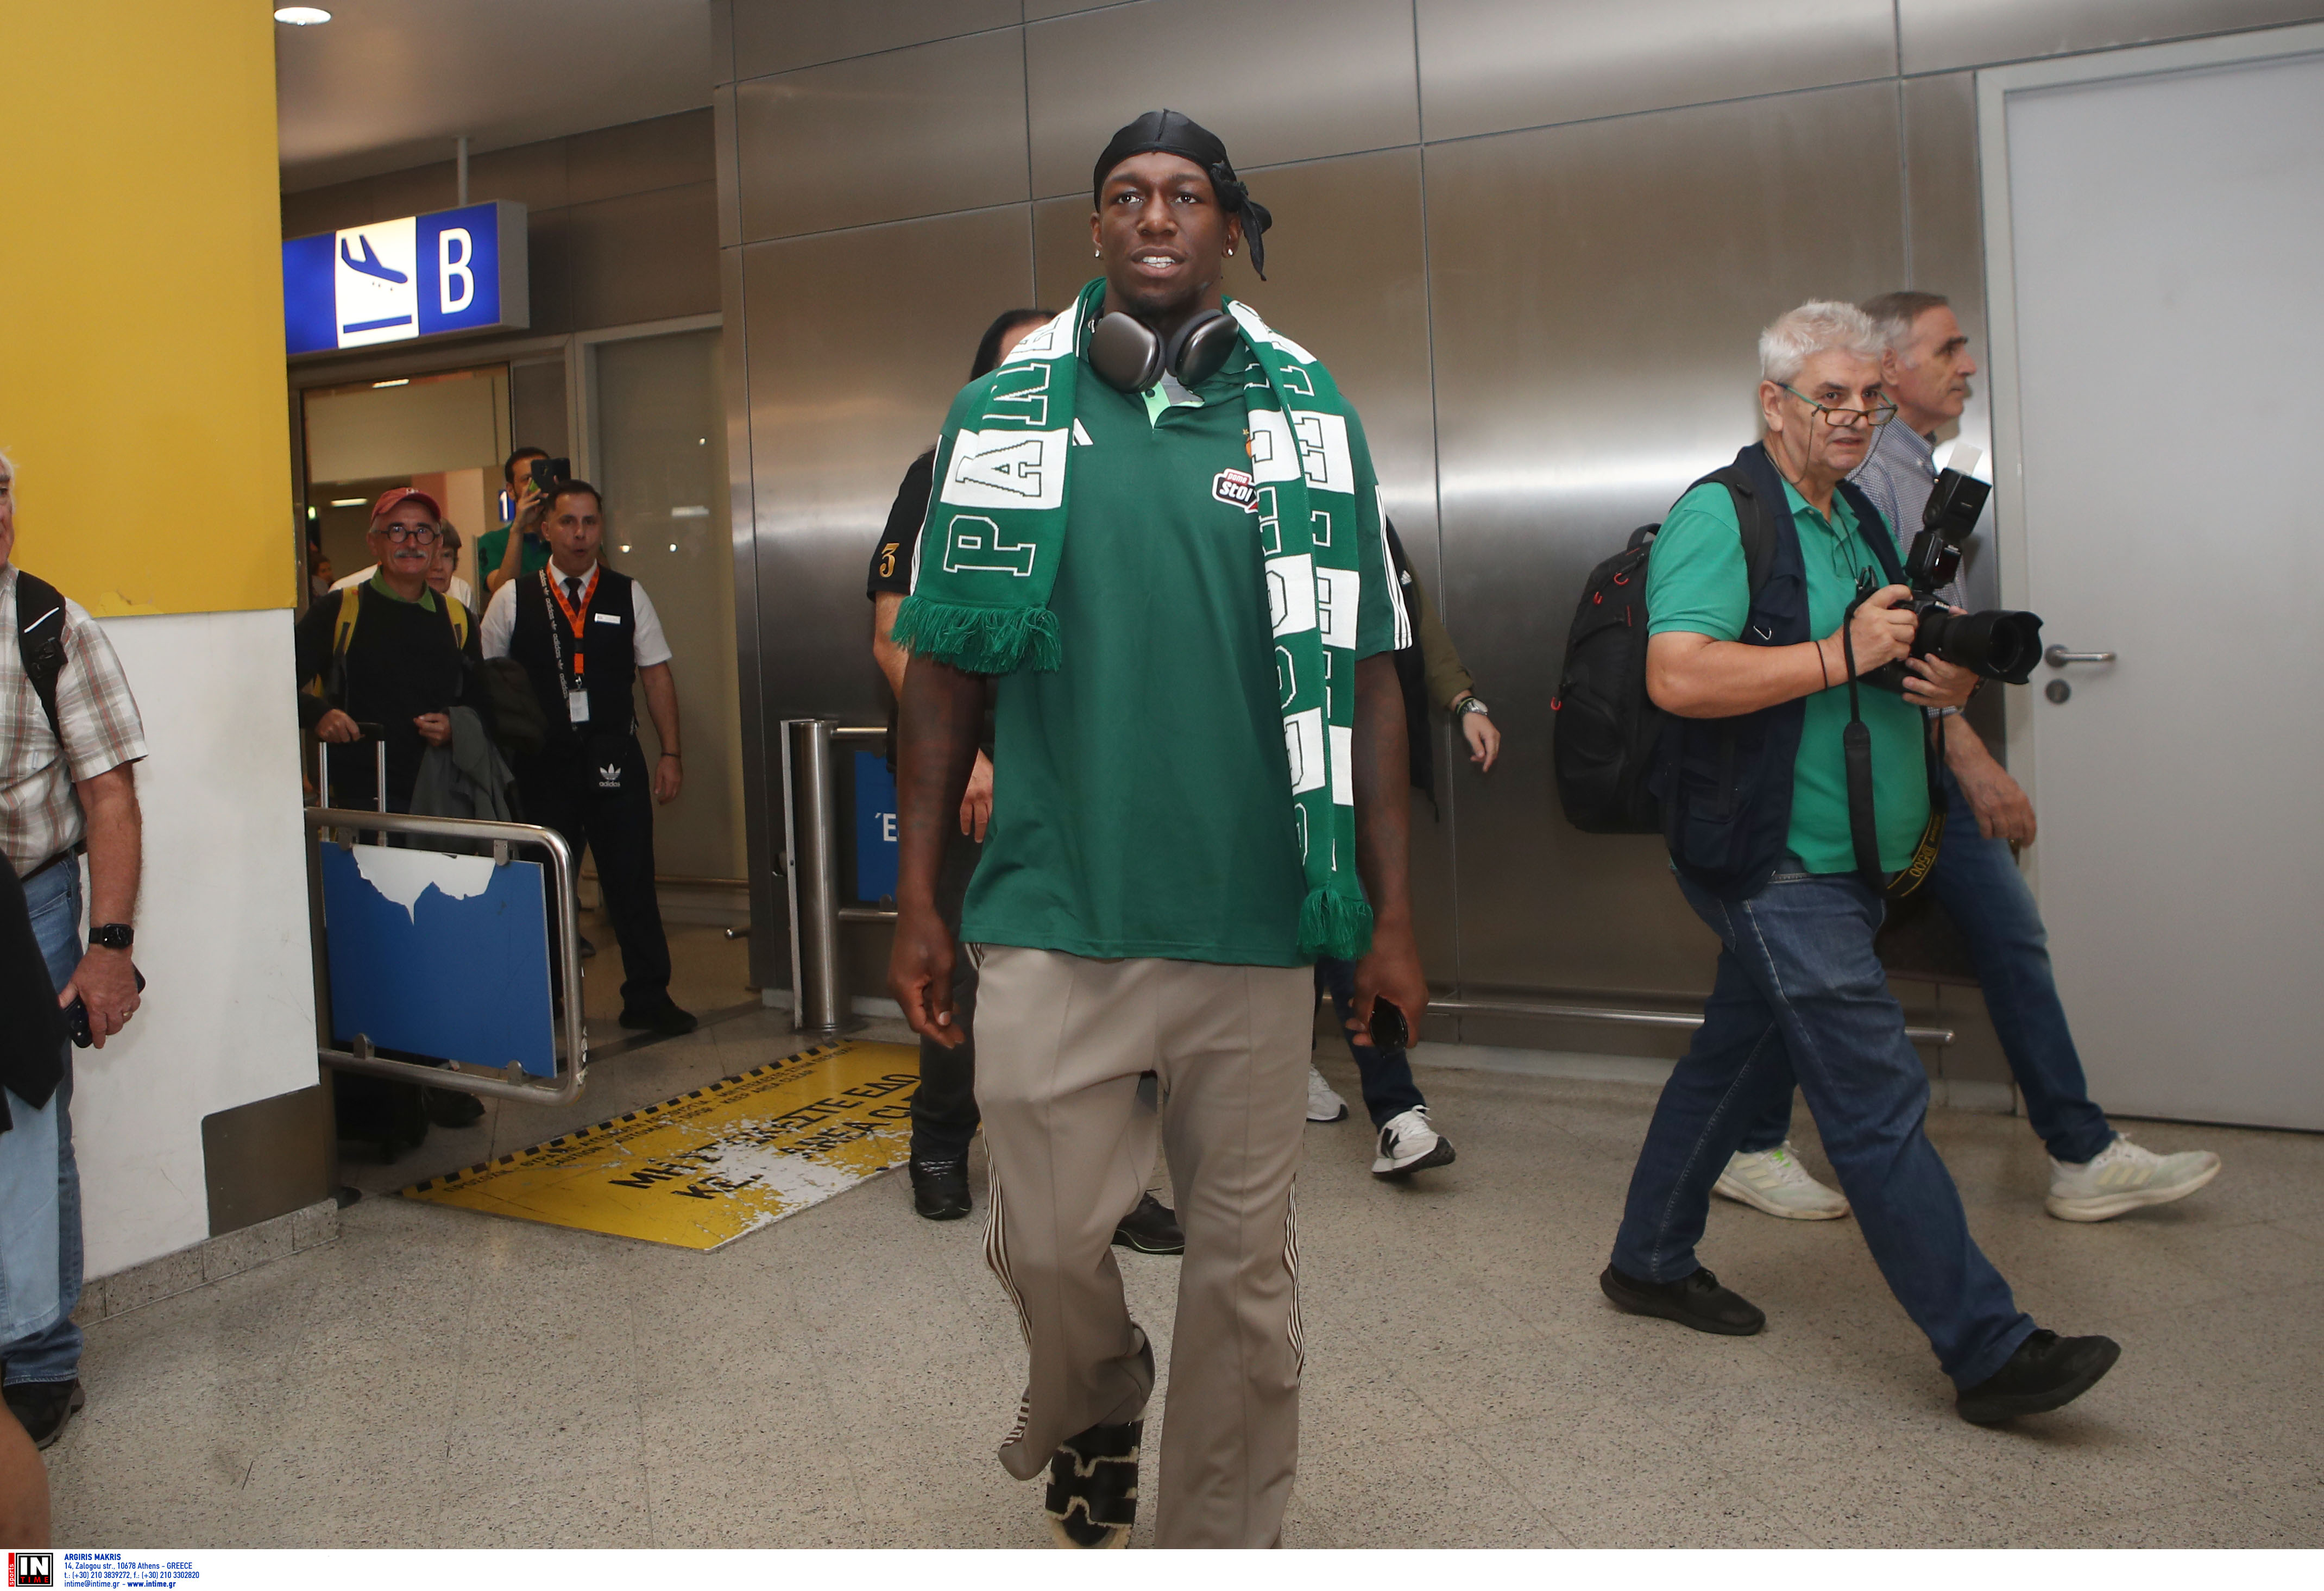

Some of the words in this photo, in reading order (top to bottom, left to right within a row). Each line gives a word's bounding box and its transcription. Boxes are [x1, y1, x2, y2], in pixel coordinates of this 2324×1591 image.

[439, 227, 474, 315] B
[1227, 473, 1248, 483] pame
[500, 491, 508, 520] 1
[880, 543, 899, 578] 3
[546, 598, 555, 620] adidas
[553, 633, 561, 658] adidas
[559, 673, 569, 699] adidas
[874, 812, 899, 841] Έ
[842, 1074, 921, 1098] ΕΔΩ
